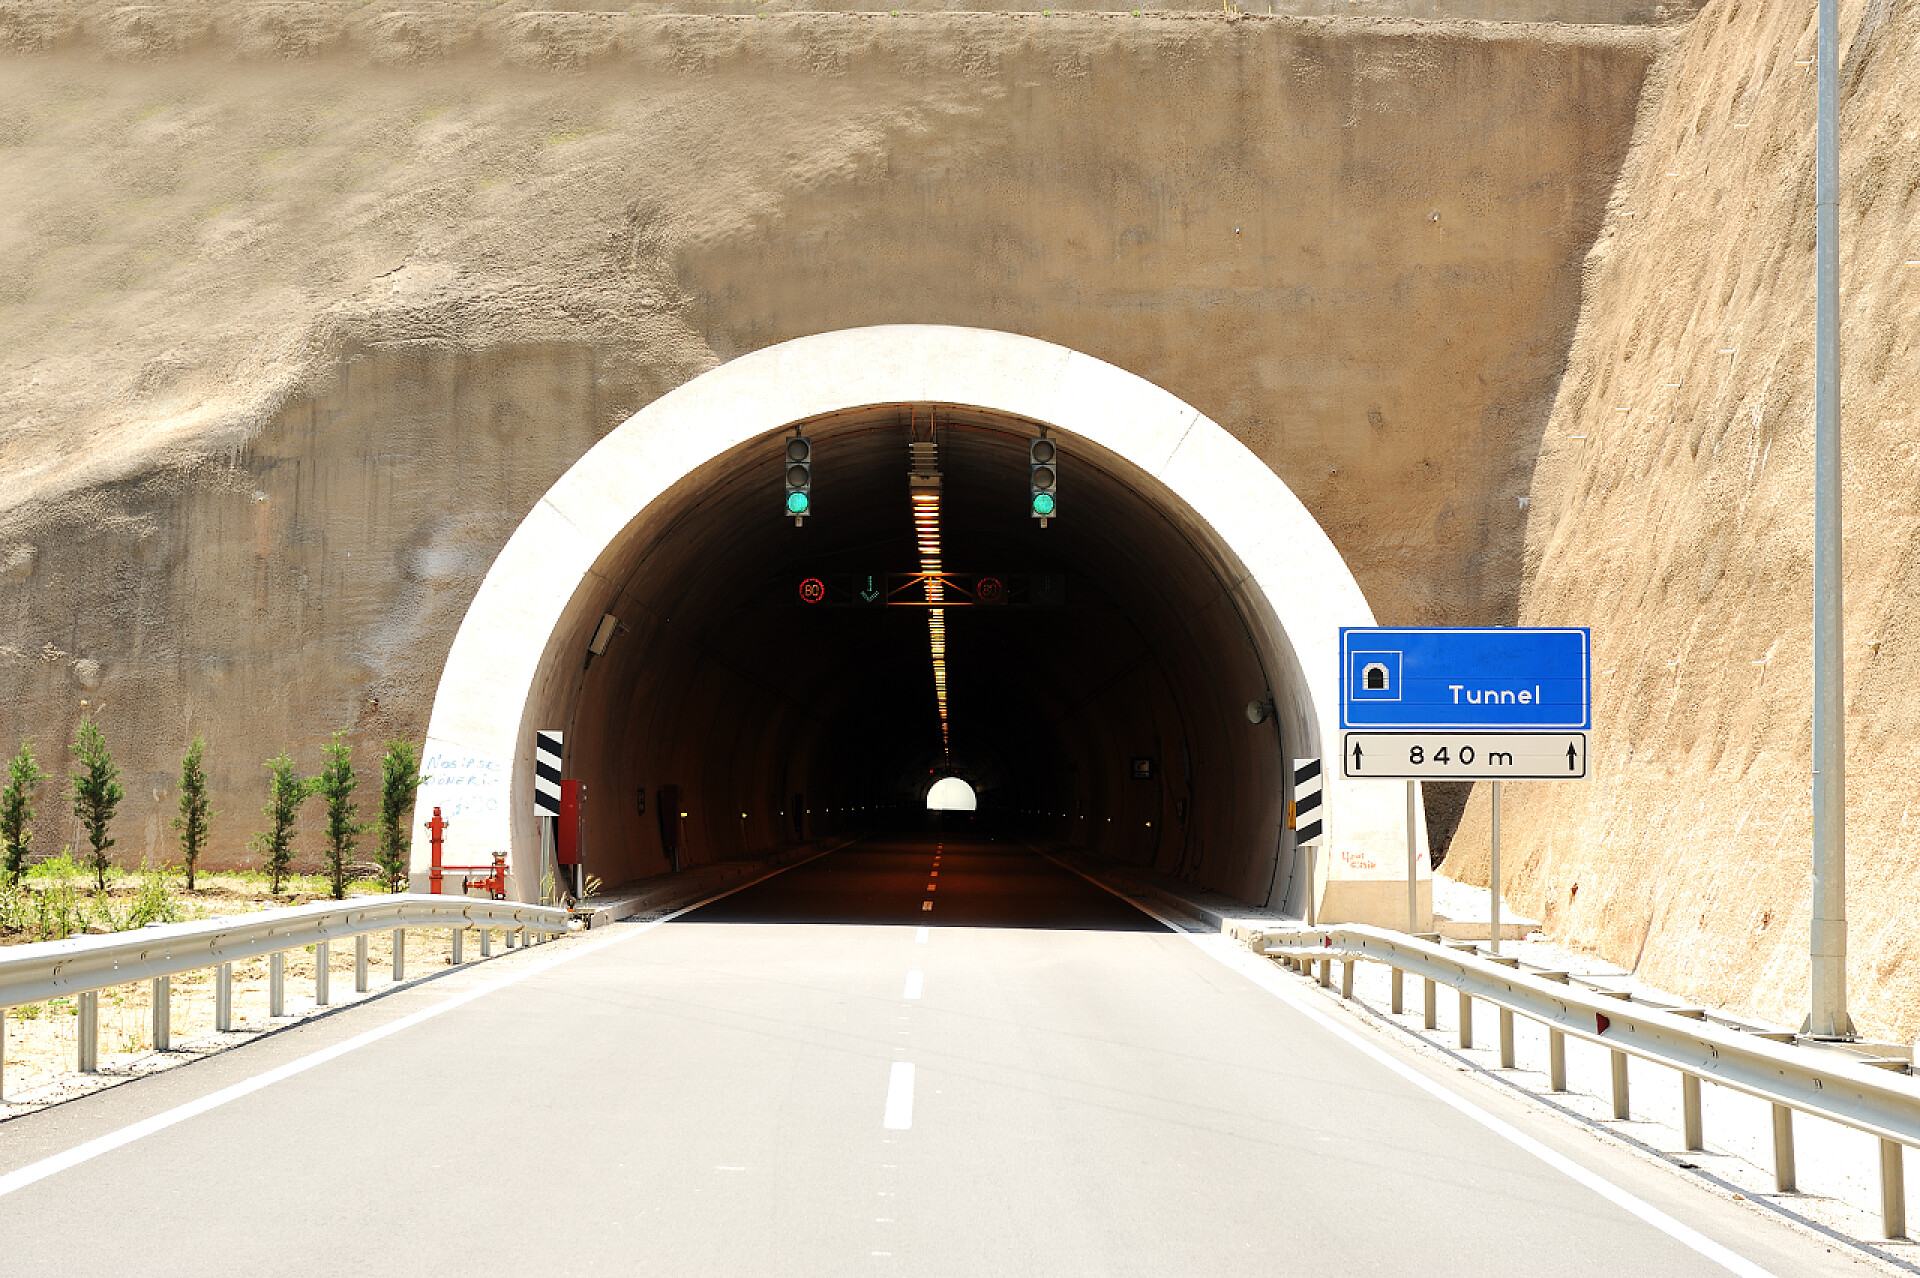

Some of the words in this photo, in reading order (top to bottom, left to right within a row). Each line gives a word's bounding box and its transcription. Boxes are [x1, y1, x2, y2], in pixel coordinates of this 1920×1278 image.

[805, 584, 820, 597] 80
[1449, 685, 1540, 705] Tunnel
[1409, 745, 1475, 766] 840
[1488, 751, 1513, 766] m
